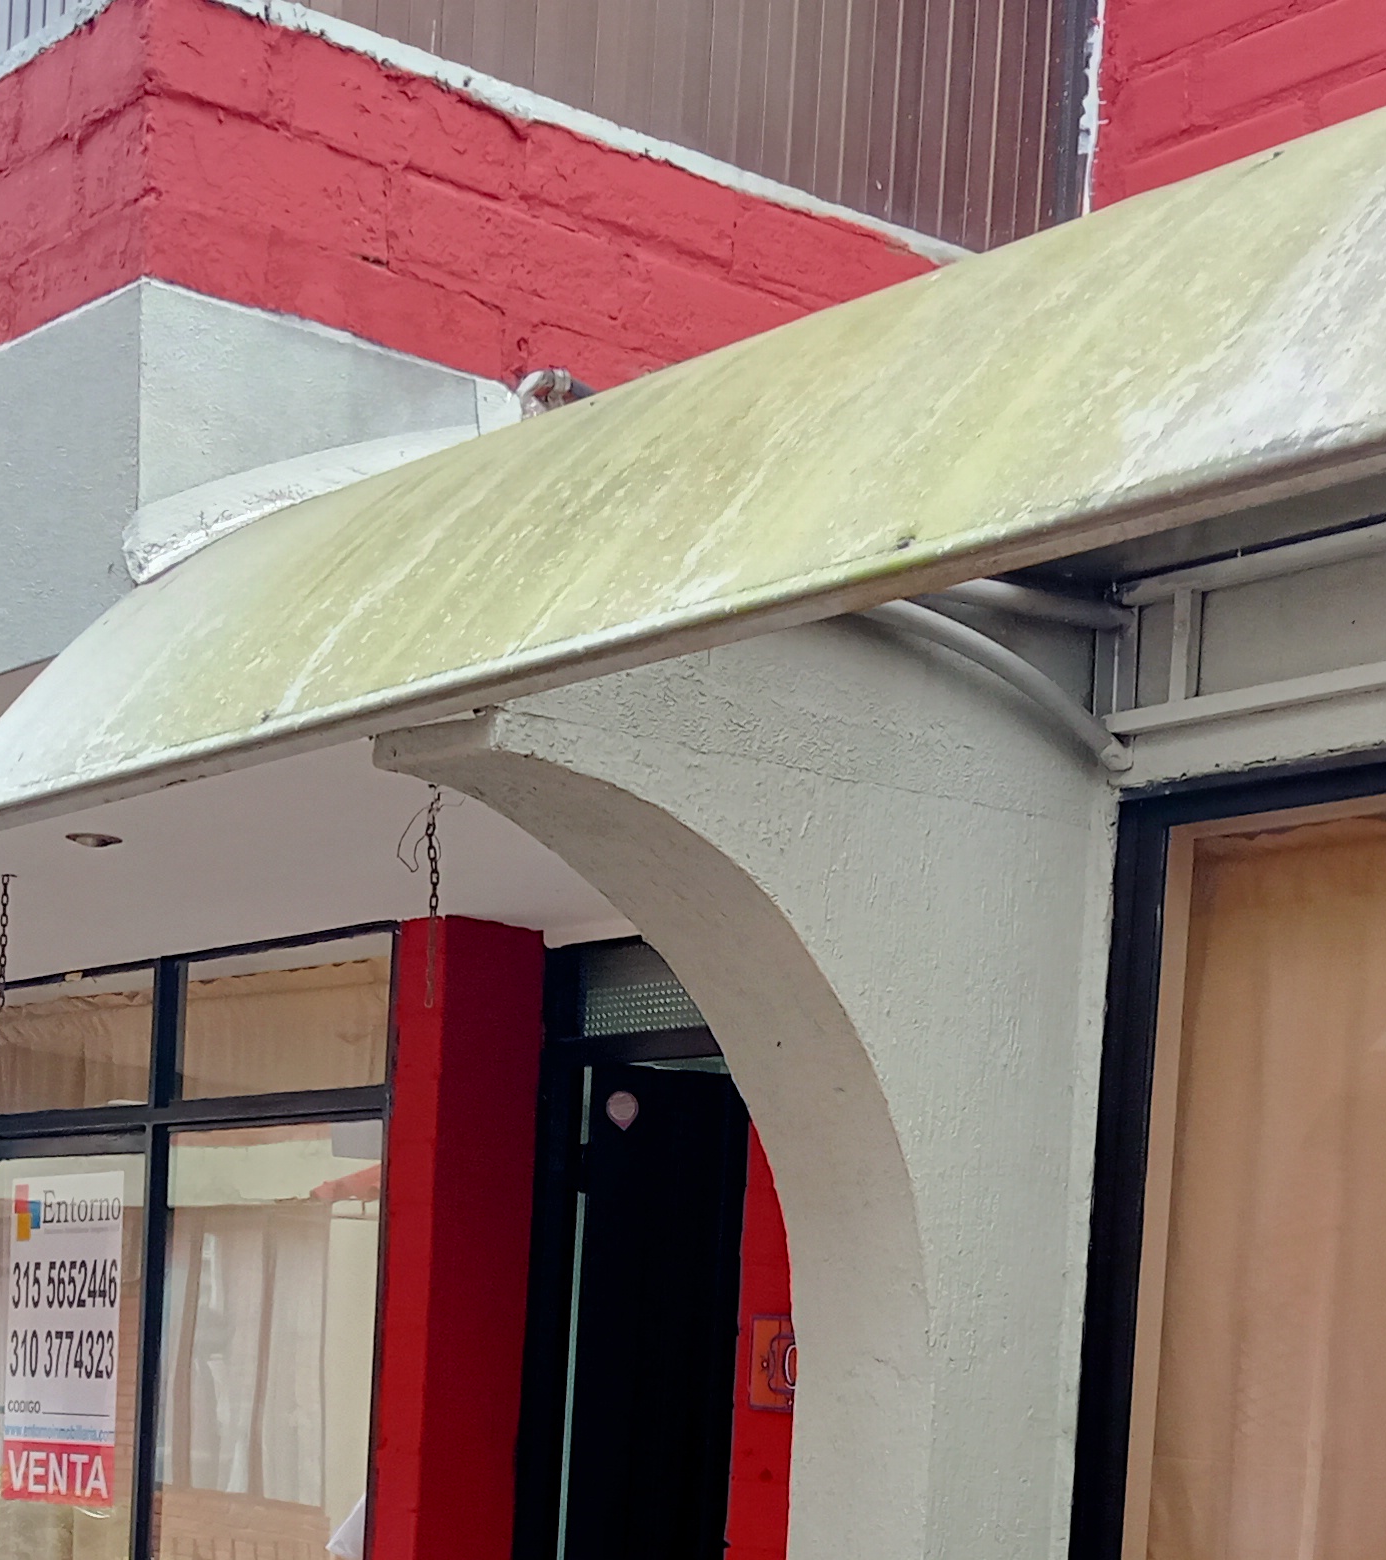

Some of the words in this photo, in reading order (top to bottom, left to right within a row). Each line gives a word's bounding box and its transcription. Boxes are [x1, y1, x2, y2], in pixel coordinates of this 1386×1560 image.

[42, 1190, 121, 1223] Entorno
[12, 1261, 41, 1309] 315
[46, 1259, 118, 1309] 5652446
[9, 1329, 39, 1378] 310
[44, 1329, 114, 1379] 3774323
[7, 1400, 41, 1414] CODIGO
[7, 1449, 109, 1499] VENTA
